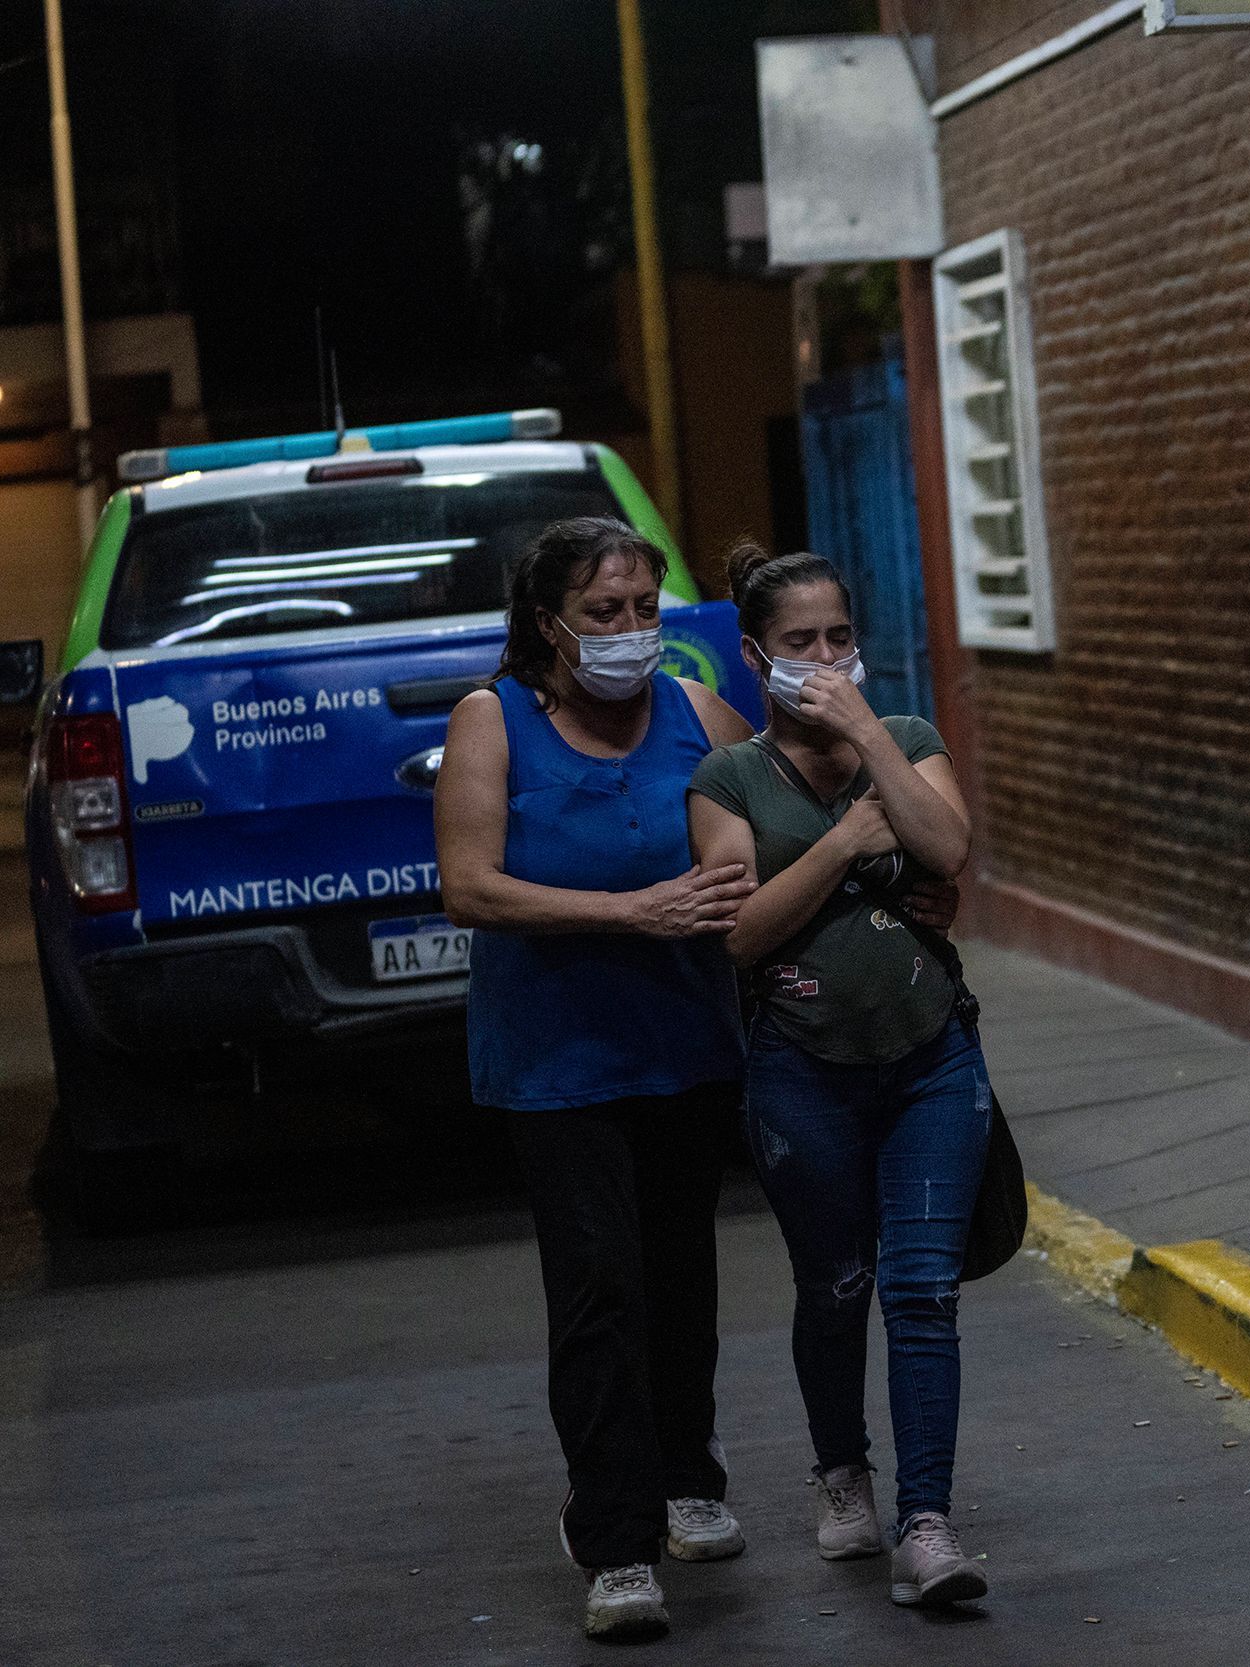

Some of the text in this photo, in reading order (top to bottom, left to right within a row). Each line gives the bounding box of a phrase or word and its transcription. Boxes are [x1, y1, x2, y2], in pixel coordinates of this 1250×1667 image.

[212, 687, 381, 724] Buenos Aires
[215, 722, 327, 751] Provincia
[169, 861, 441, 918] MANTENGA DIST
[384, 940, 420, 971] AA
